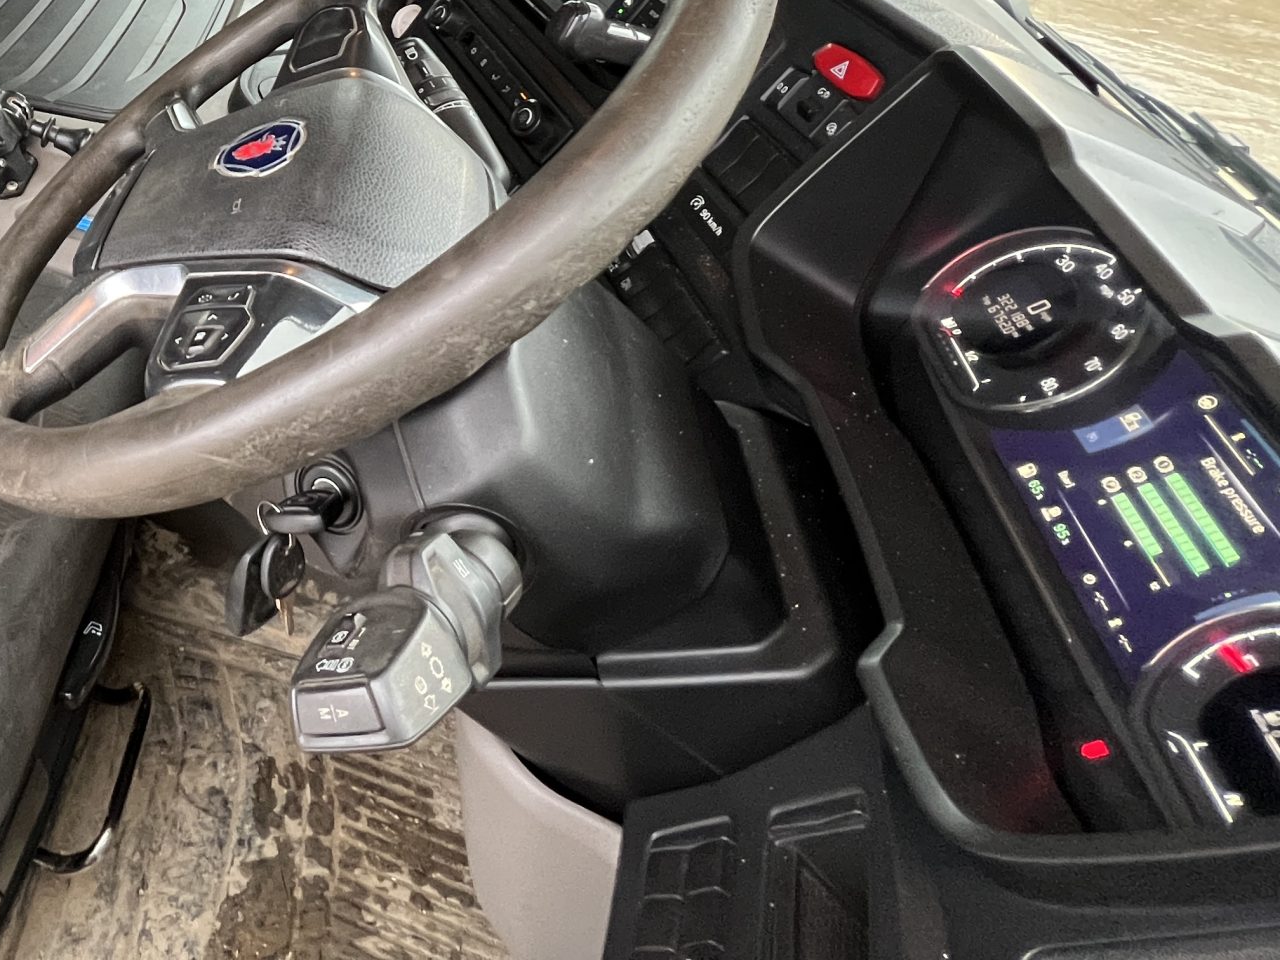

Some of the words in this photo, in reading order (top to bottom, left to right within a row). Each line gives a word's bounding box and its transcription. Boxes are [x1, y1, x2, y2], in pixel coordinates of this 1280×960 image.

[699, 208, 712, 221] 90
[706, 216, 723, 237] km/h
[1054, 253, 1076, 273] 30
[1095, 263, 1114, 280] 40
[1117, 288, 1136, 306] 50
[996, 292, 1018, 312] 322
[1010, 311, 1030, 329] 188
[1026, 299, 1052, 315] 0
[1111, 323, 1129, 339] 60
[1083, 356, 1101, 371] 70
[1040, 377, 1059, 391] 80
[1200, 456, 1229, 487] Brake
[1220, 486, 1266, 534] pressure
